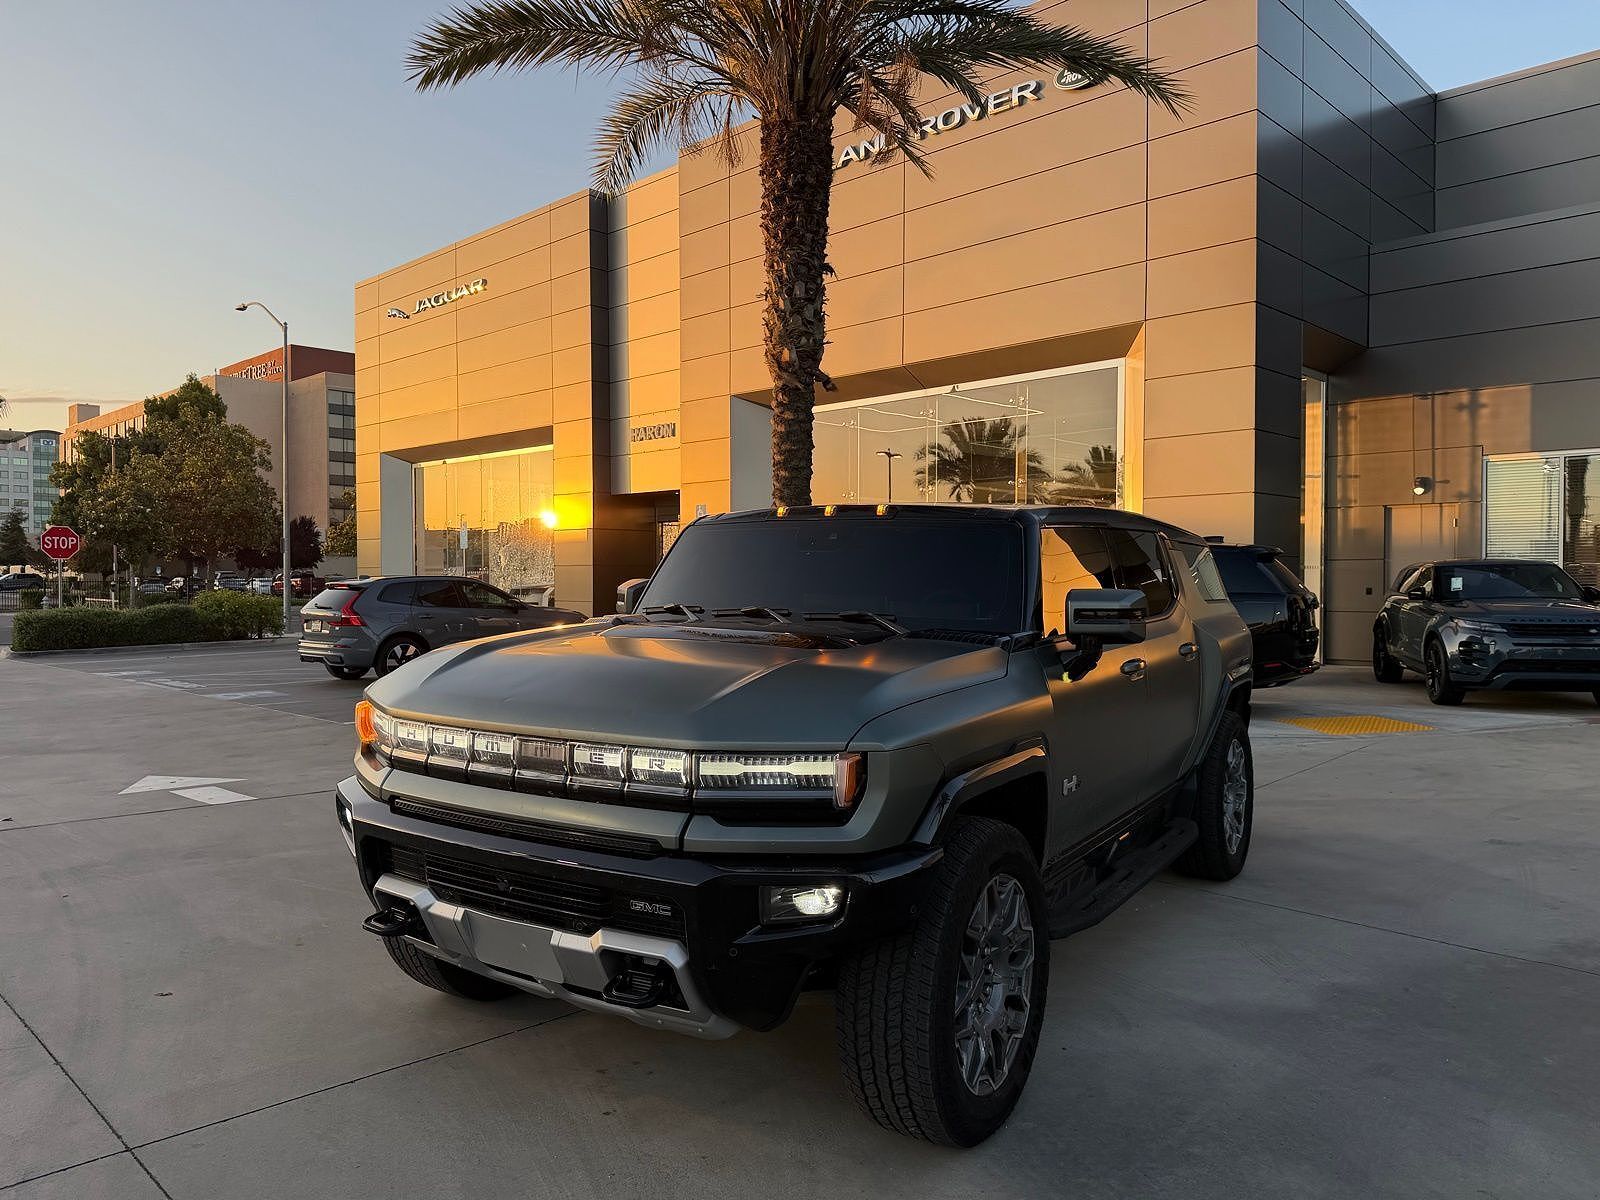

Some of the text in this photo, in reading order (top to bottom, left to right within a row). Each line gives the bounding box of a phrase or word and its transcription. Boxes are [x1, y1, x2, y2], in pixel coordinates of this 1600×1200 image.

[914, 80, 1039, 140] ROVER
[411, 278, 487, 314] JAGUAR
[630, 422, 676, 442] HARON
[44, 536, 77, 549] STOP
[630, 900, 671, 916] GMC
